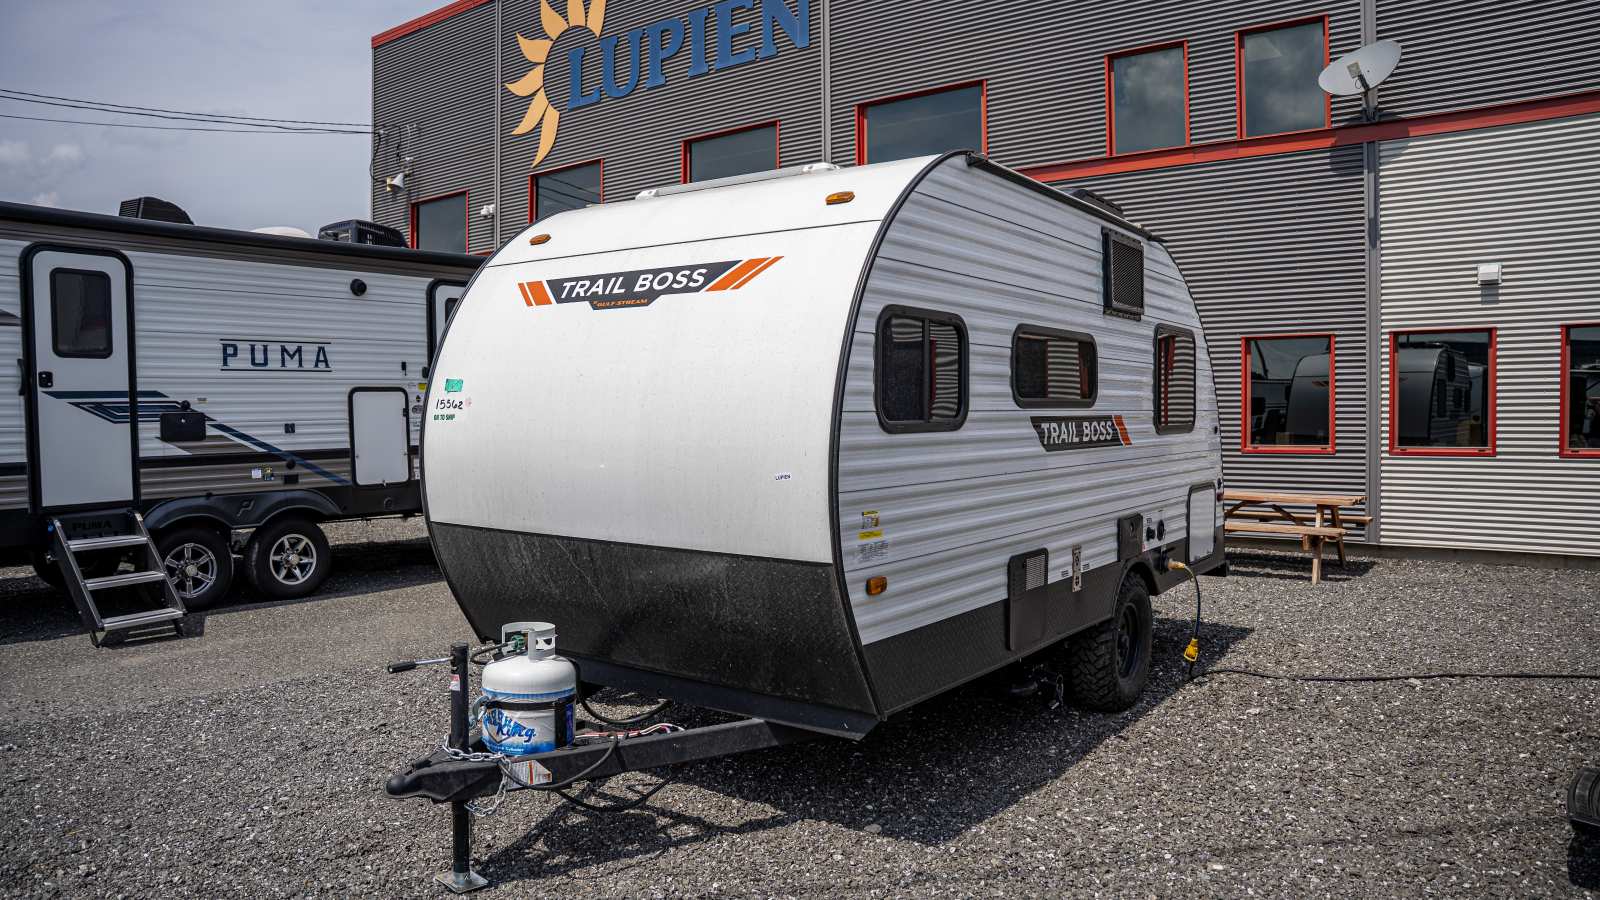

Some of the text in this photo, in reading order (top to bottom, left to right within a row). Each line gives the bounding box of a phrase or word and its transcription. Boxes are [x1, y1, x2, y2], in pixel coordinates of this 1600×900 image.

[567, 0, 810, 111] LUPIEN
[560, 268, 709, 299] TRAIL BOSS
[221, 343, 331, 369] PUMA
[436, 399, 463, 410] 15562
[1041, 421, 1113, 444] TRAIL BOSS
